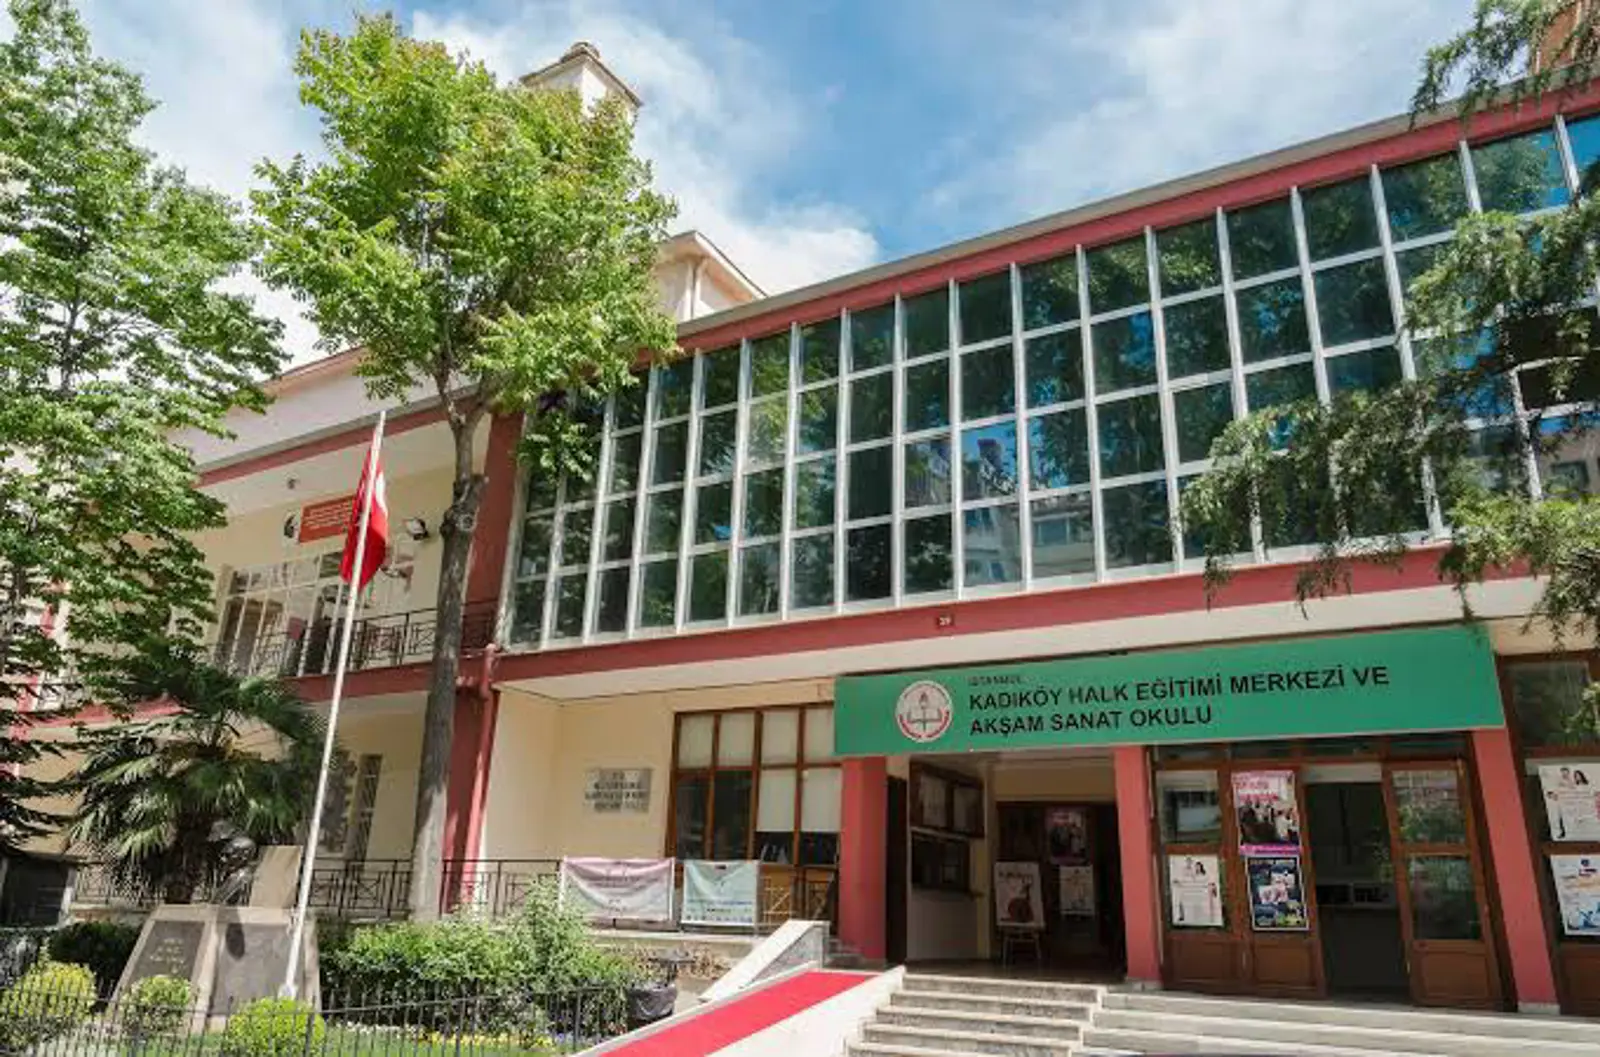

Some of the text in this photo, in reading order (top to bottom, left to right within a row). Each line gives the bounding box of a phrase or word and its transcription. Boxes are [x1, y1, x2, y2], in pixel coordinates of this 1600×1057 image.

[969, 664, 1389, 710] KADIKÖY HALK EĞİTİMİ MERKEZİ VE
[970, 705, 1211, 738] AKŞAM SANAT OKULU
